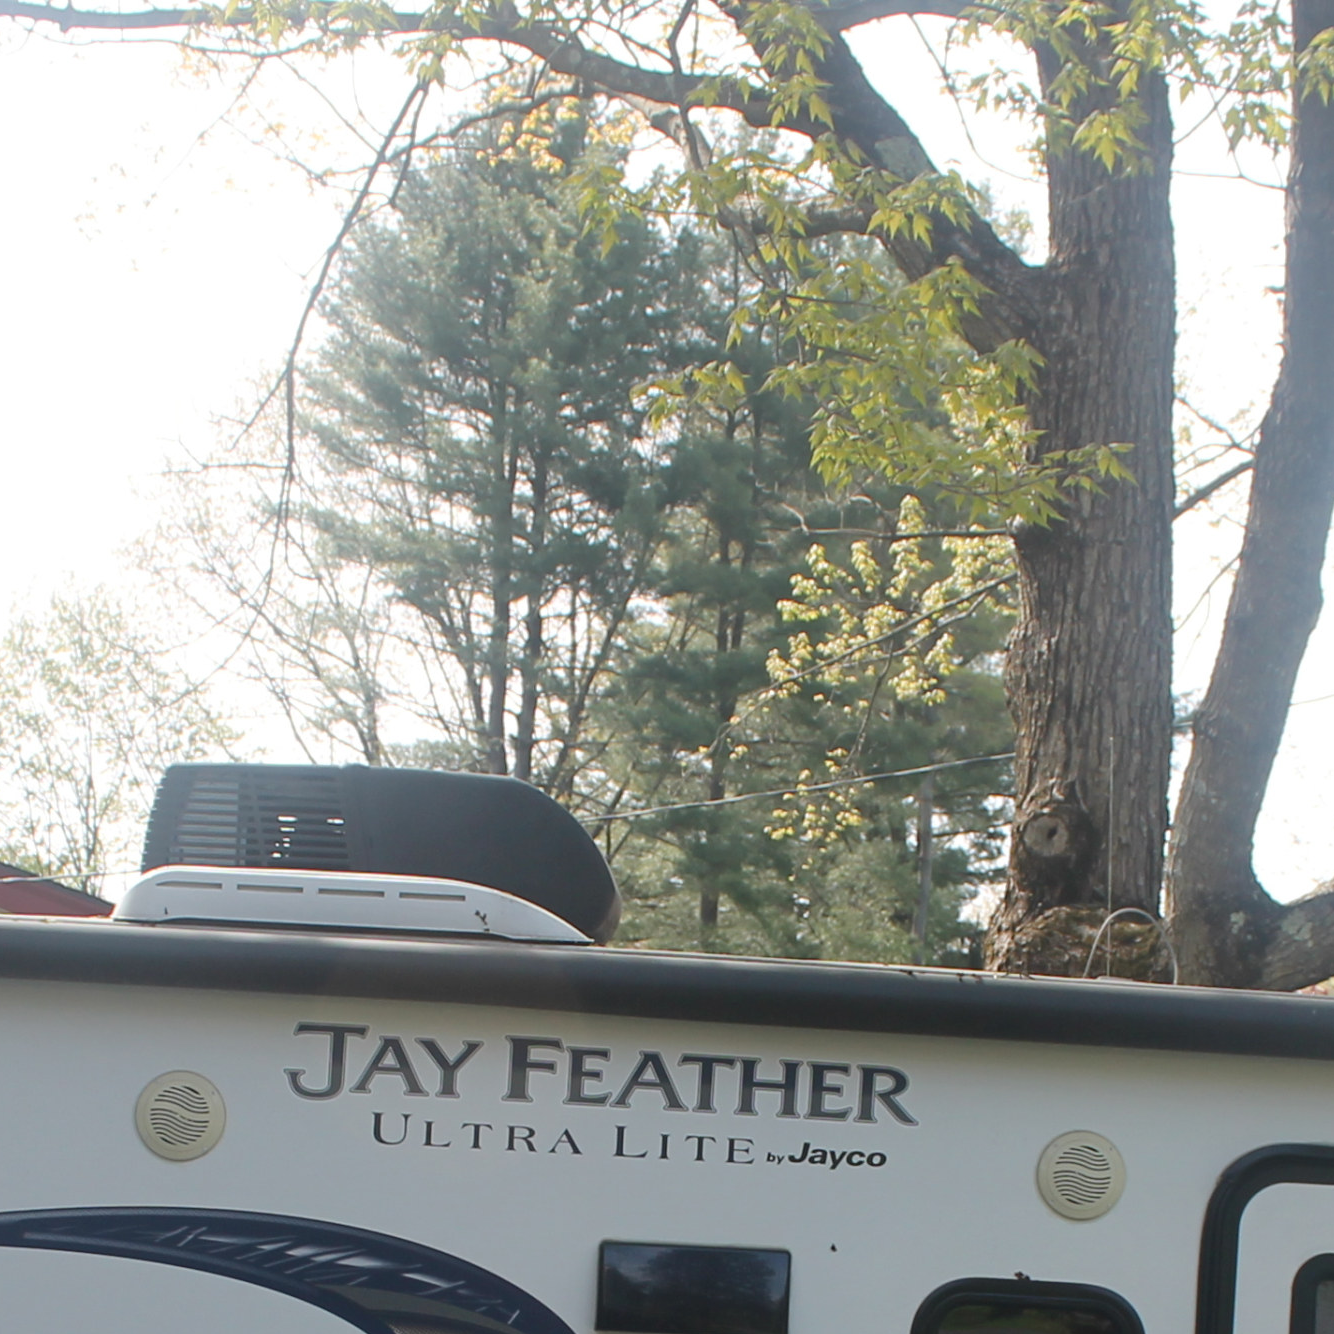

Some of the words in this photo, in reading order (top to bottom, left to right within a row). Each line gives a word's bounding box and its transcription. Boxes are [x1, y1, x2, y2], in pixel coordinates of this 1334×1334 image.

[283, 1020, 485, 1101] JAY
[500, 1034, 919, 1127] FEATHER
[371, 1111, 584, 1157] ULTRA
[613, 1124, 755, 1165] LITE
[766, 1151, 785, 1166] by
[787, 1142, 887, 1170] Jayco
